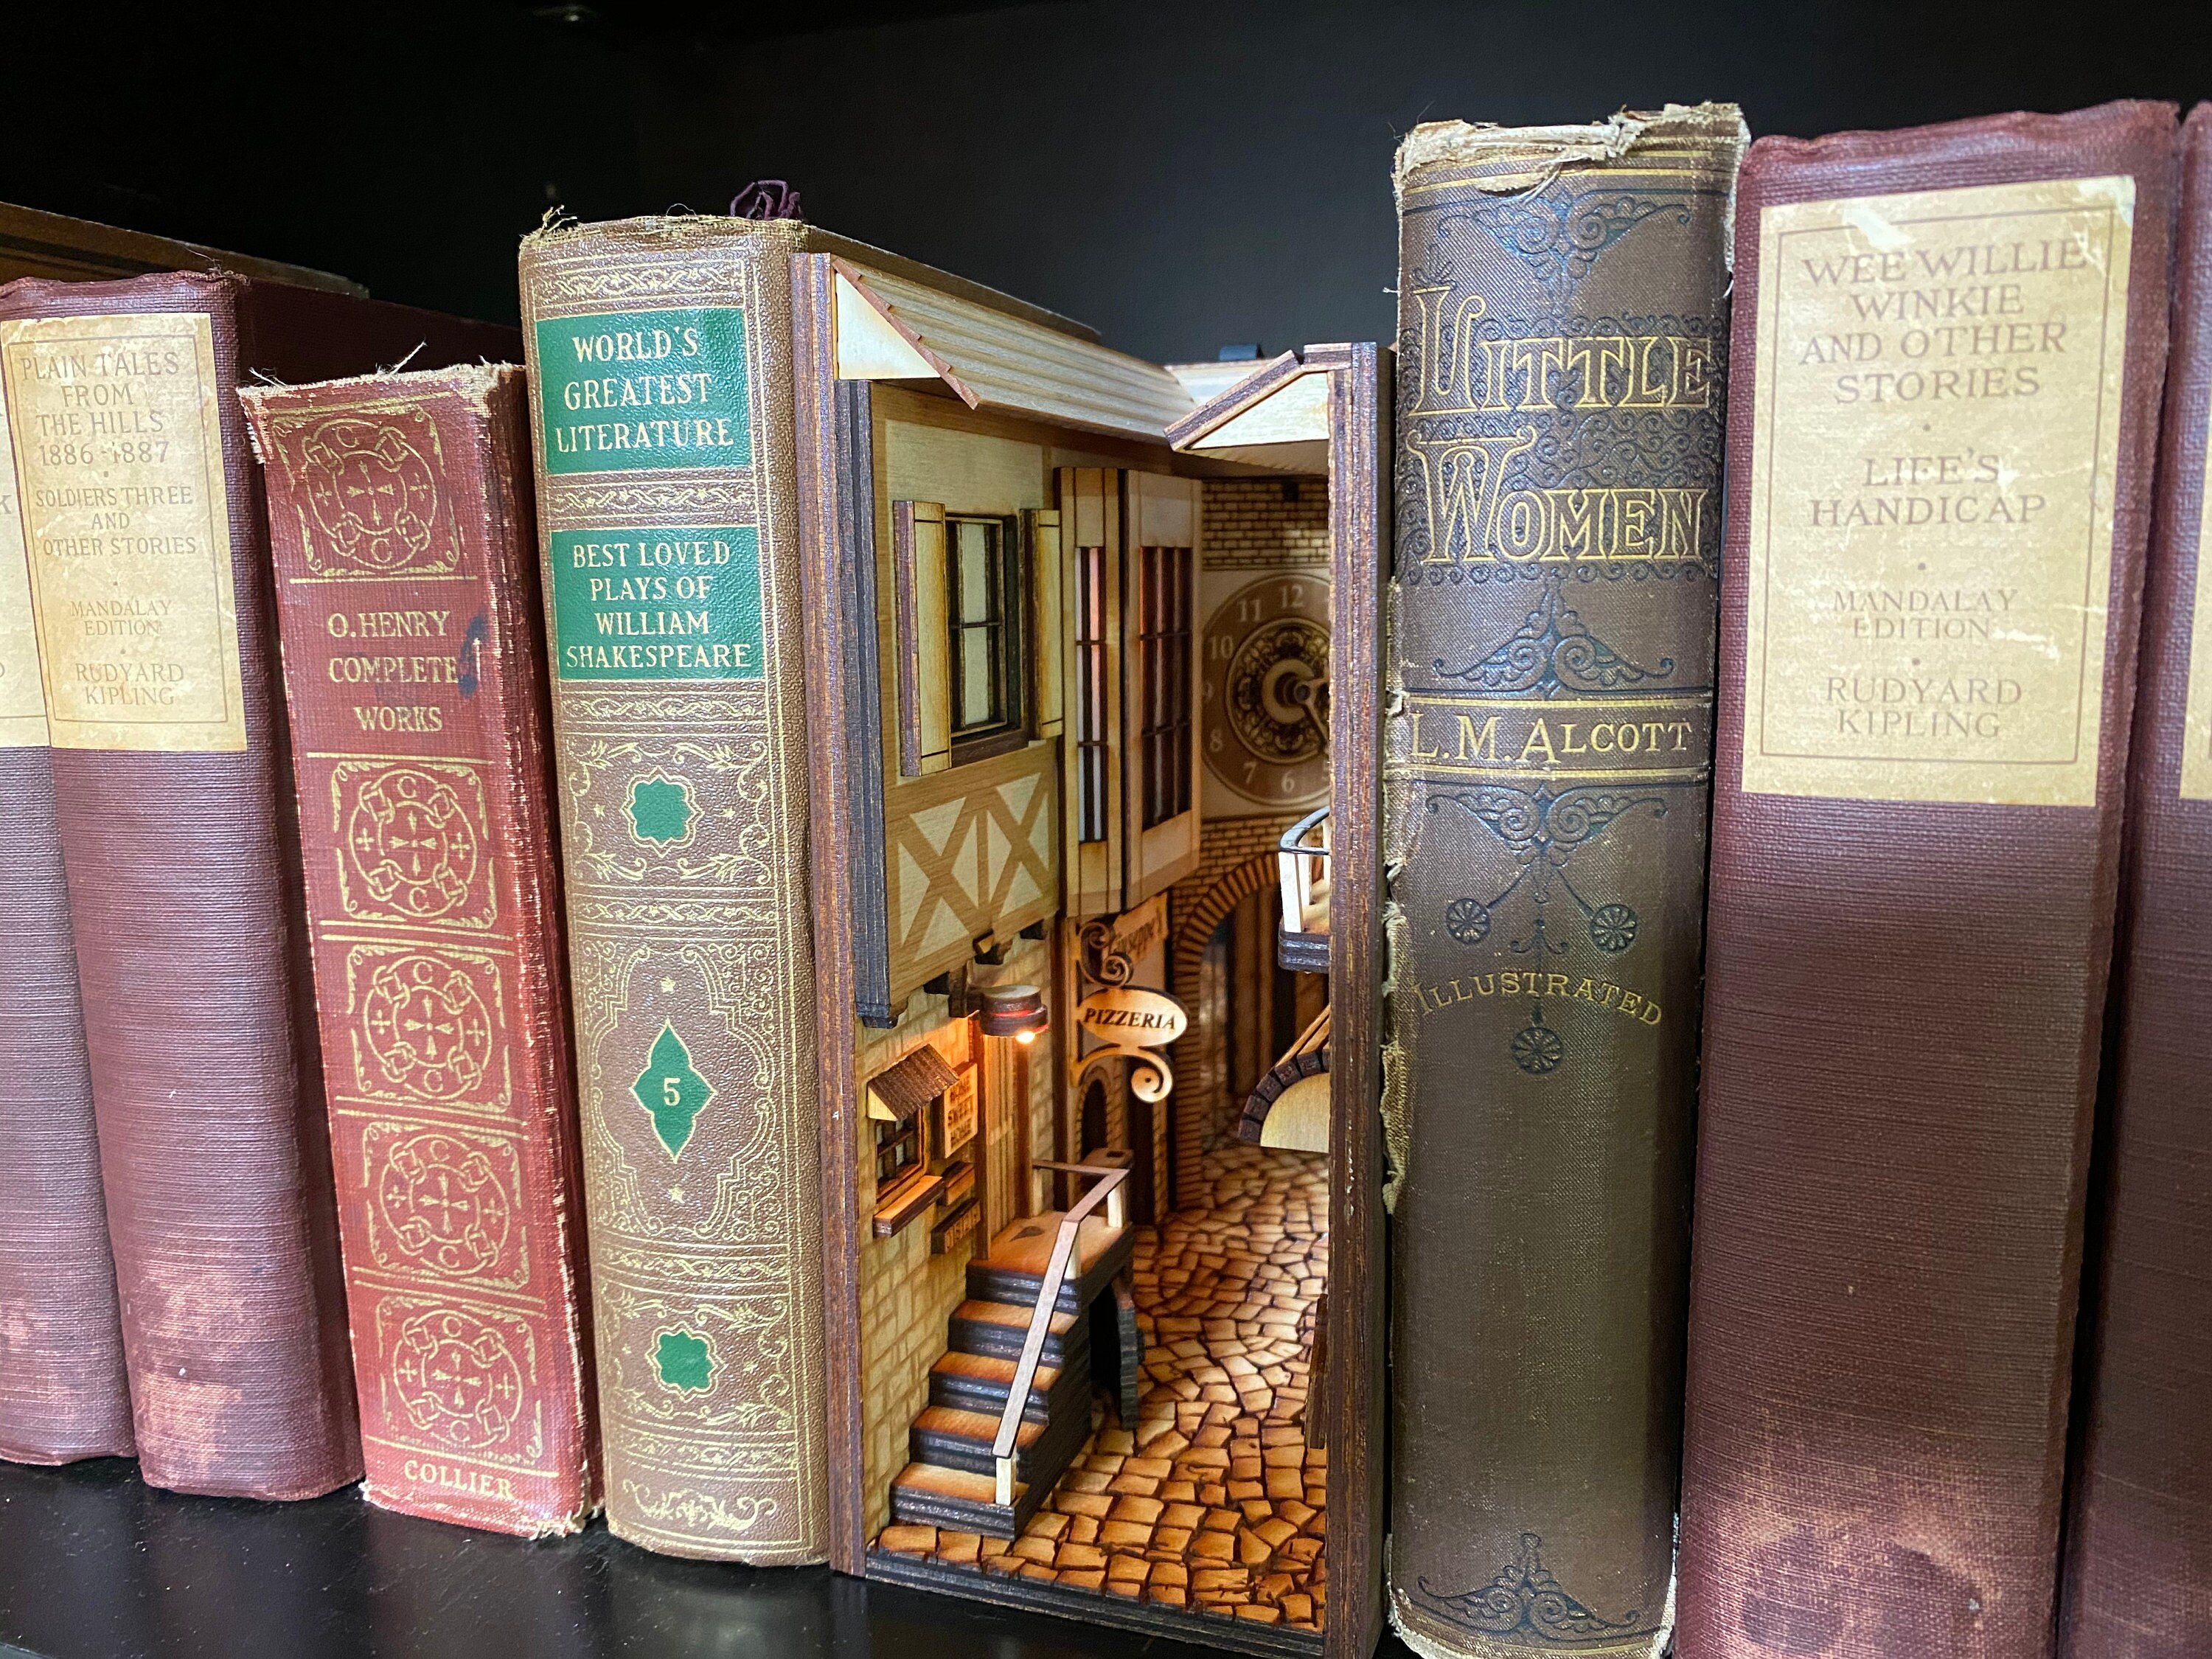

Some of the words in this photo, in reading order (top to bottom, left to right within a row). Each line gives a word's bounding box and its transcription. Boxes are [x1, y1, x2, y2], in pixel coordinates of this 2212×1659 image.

[1803, 252, 1907, 286] WEE
[1917, 238, 2088, 277] WILLIE
[1850, 284, 2024, 322] WINKIE
[572, 327, 698, 363] WORLD'S
[1408, 285, 1711, 417] LITTLE
[1799, 331, 1882, 366] AND
[1900, 321, 2065, 360] OTHER
[21, 355, 86, 380] PLAIN
[95, 352, 179, 376] TALES
[61, 383, 133, 407] FROM
[564, 372, 712, 411] GREATEST
[1835, 366, 2040, 404] STORIES
[36, 414, 82, 436] THE
[89, 411, 163, 434] HILLS
[557, 417, 734, 453] LITERATURE
[1863, 448, 2000, 487] LIFE'S
[36, 487, 117, 507] SOLDIERS
[122, 486, 193, 505] THREE
[1406, 425, 1708, 563] WOMEN
[91, 512, 130, 530] AND
[1810, 494, 2045, 527] HANDICAP
[43, 538, 103, 556] OTHER
[111, 537, 196, 555] STORIES
[574, 543, 630, 569] BEST
[639, 541, 731, 567] LOVED
[591, 577, 665, 602] PLAYS
[676, 576, 714, 599] OF
[1238, 598, 1262, 622] 11
[1280, 583, 1304, 609] 12
[1833, 588, 2018, 612] MANDALAY
[71, 600, 173, 617] MANDALAY
[85, 619, 159, 636] EDITION
[594, 611, 710, 636] WILLIAM
[1853, 616, 1991, 640] EDITION
[566, 643, 751, 669] SHAKESPEARE
[1209, 635, 1234, 660] 10
[76, 664, 184, 683] RUDYARD
[329, 656, 459, 684] COMPLETE
[85, 686, 175, 706] KIPLING
[1826, 677, 2023, 706] RUDYARD
[353, 706, 443, 732] WORKS
[1837, 710, 2000, 739] KIPLING
[1209, 728, 1222, 753] 8
[1243, 762, 1257, 785] 7
[1281, 772, 1295, 793] 6
[1411, 971, 1663, 1026] ILLUSTRATED
[1083, 1007, 1176, 1030] PIZZERIA
[664, 1077, 681, 1106] 5
[404, 1460, 516, 1500] COLLIER
